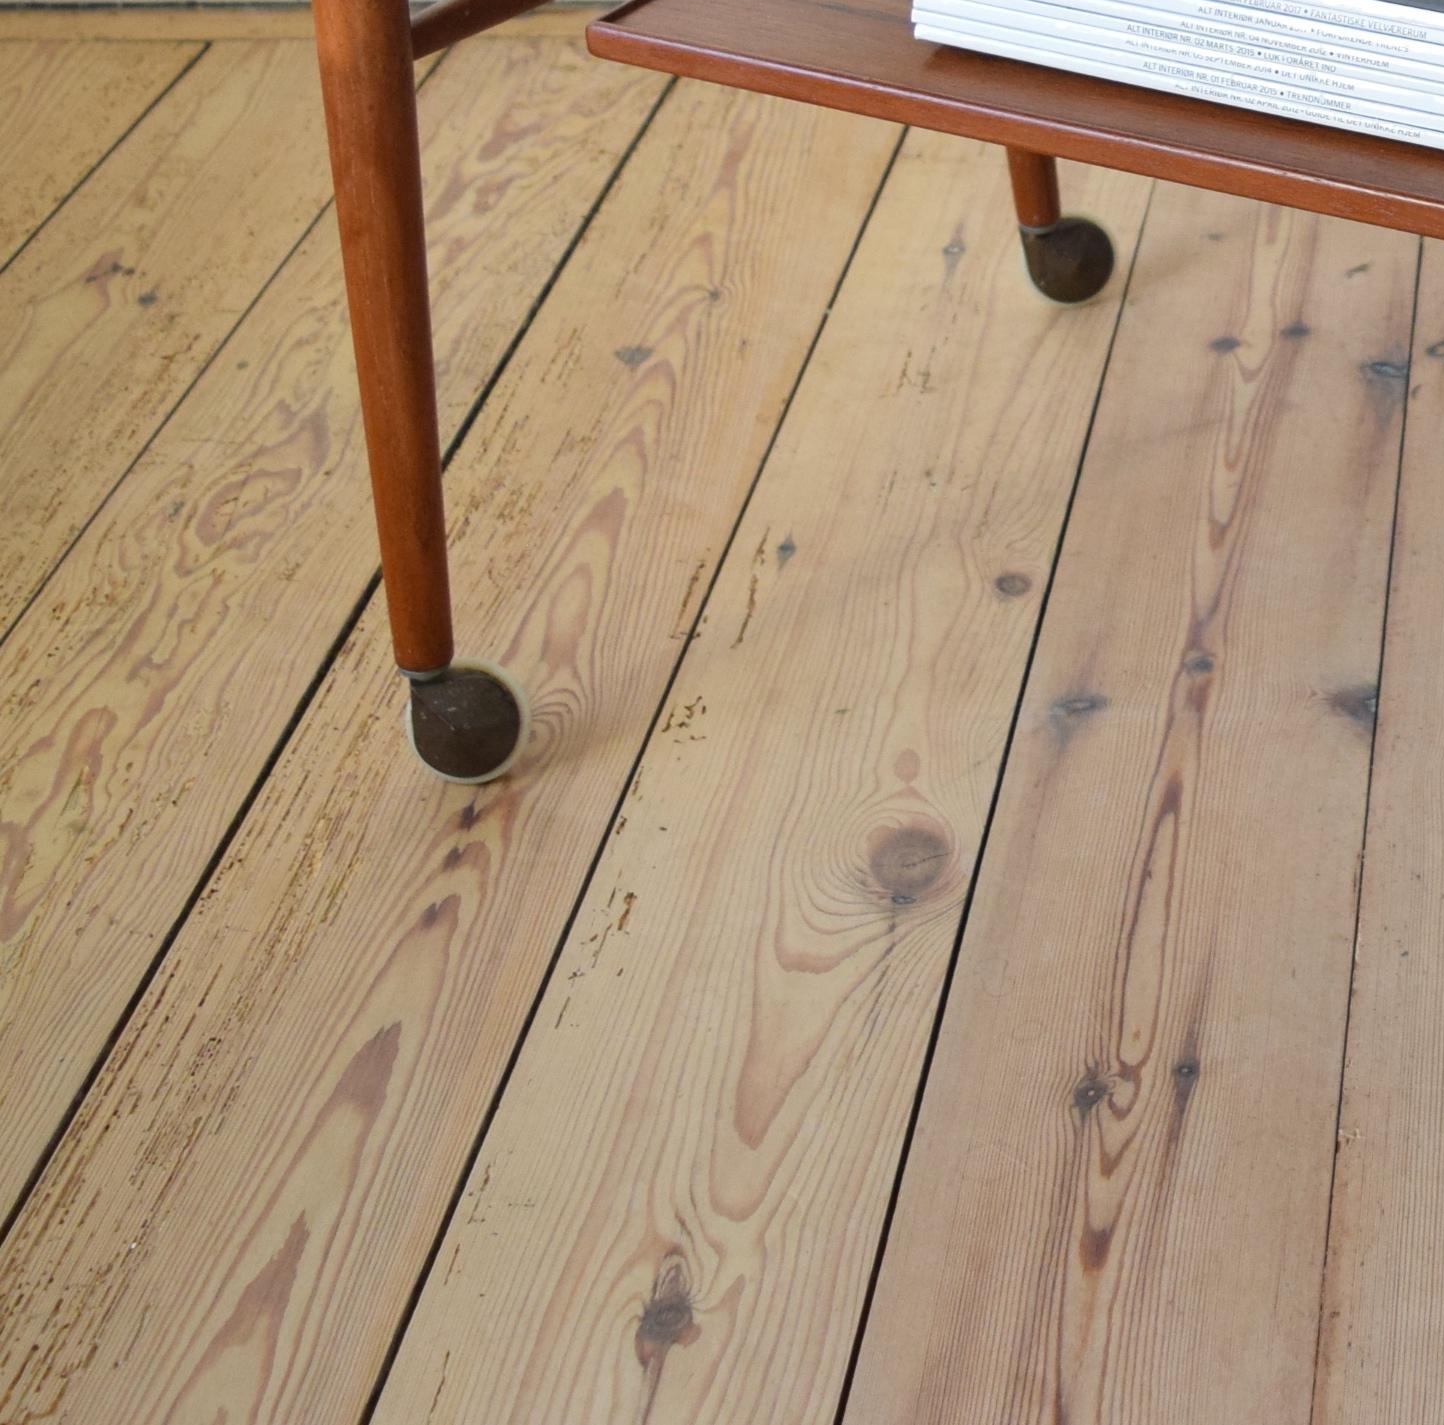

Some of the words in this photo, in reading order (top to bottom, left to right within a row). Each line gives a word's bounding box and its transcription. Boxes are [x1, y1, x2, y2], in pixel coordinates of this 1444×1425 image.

[1127, 24, 1142, 33] ALT
[1142, 27, 1179, 41] INTERIØR
[1263, 52, 1281, 62] LUK
[1143, 61, 1157, 70] ALT
[1221, 77, 1257, 91] FEBRUAR
[1286, 90, 1352, 110] TRENDNUMMER
